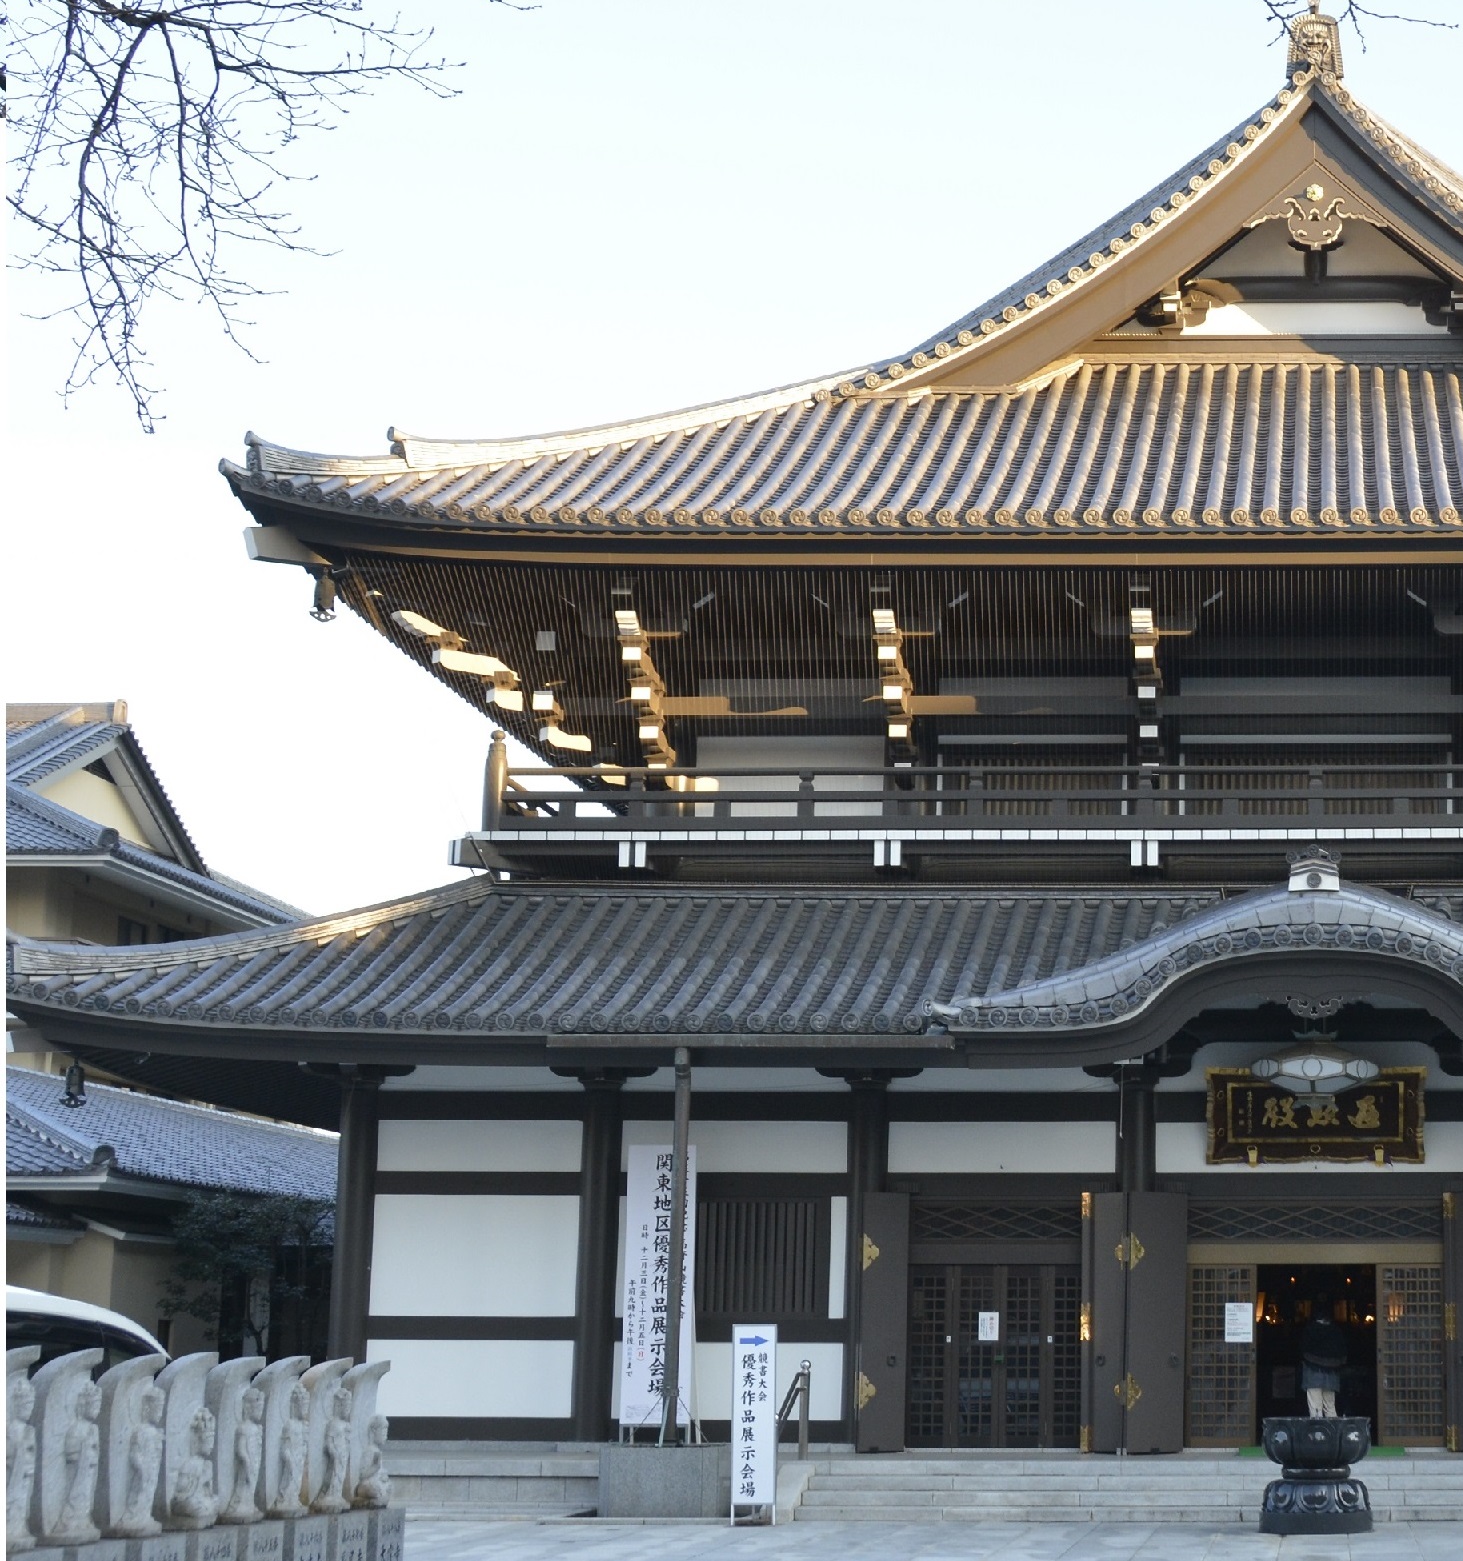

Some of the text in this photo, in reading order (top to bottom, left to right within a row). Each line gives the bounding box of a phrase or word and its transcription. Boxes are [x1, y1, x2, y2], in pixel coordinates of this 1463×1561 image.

[647, 1153, 672, 1397] 関東地区優秀作品展示会場
[740, 1353, 756, 1498] 優秀作品展示会場
